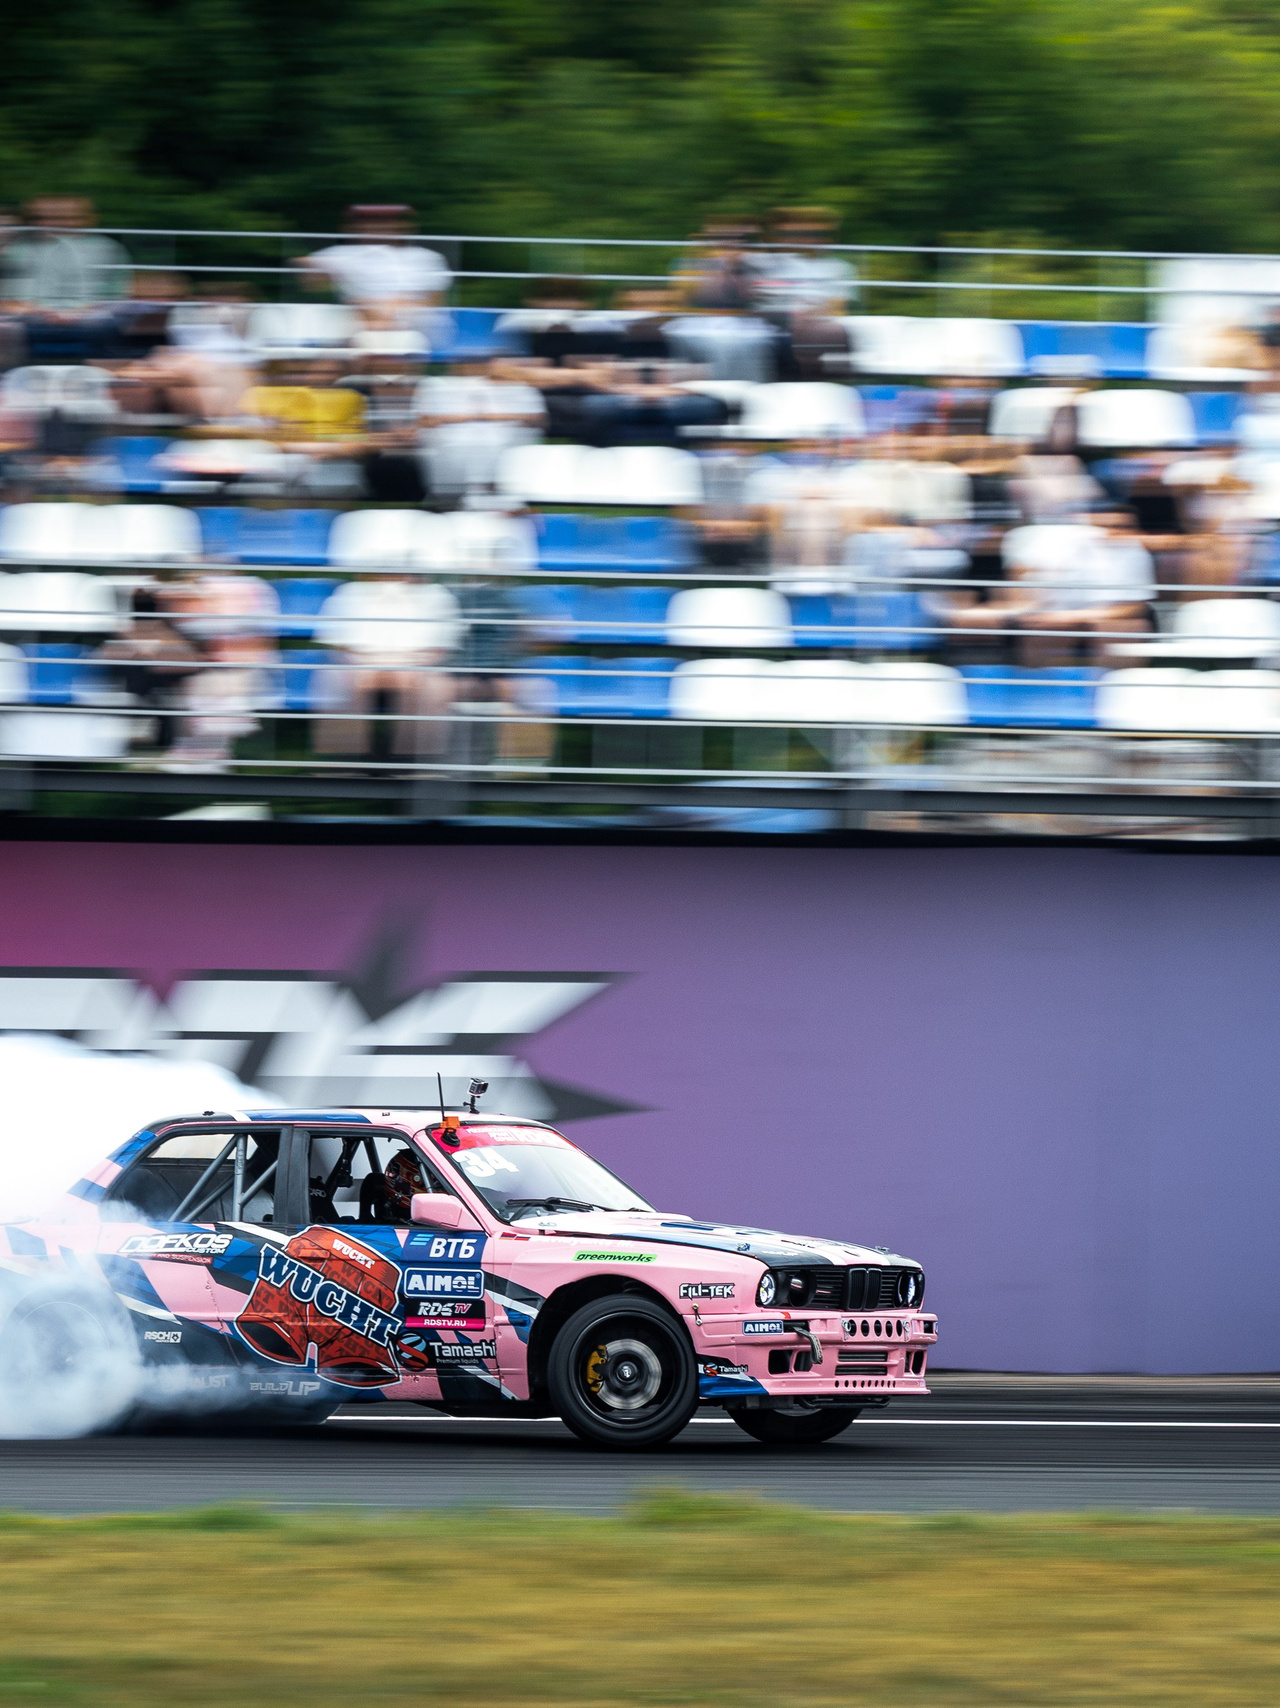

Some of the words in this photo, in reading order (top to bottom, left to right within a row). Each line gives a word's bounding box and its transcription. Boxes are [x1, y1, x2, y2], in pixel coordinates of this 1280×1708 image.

[451, 1148, 519, 1177] 34
[331, 1238, 375, 1269] WUCHT
[429, 1237, 477, 1258] ВТБ
[171, 1254, 211, 1263] SUSPENSION
[576, 1252, 653, 1263] greenworks
[407, 1274, 480, 1293] AIMOL
[259, 1243, 402, 1347] WUCHT
[423, 1319, 467, 1327] RDSTV.RU
[744, 1323, 782, 1333] AIMOL
[144, 1331, 170, 1340] RSCH
[429, 1341, 495, 1357] Tamashi
[719, 1365, 748, 1373] Tamashi
